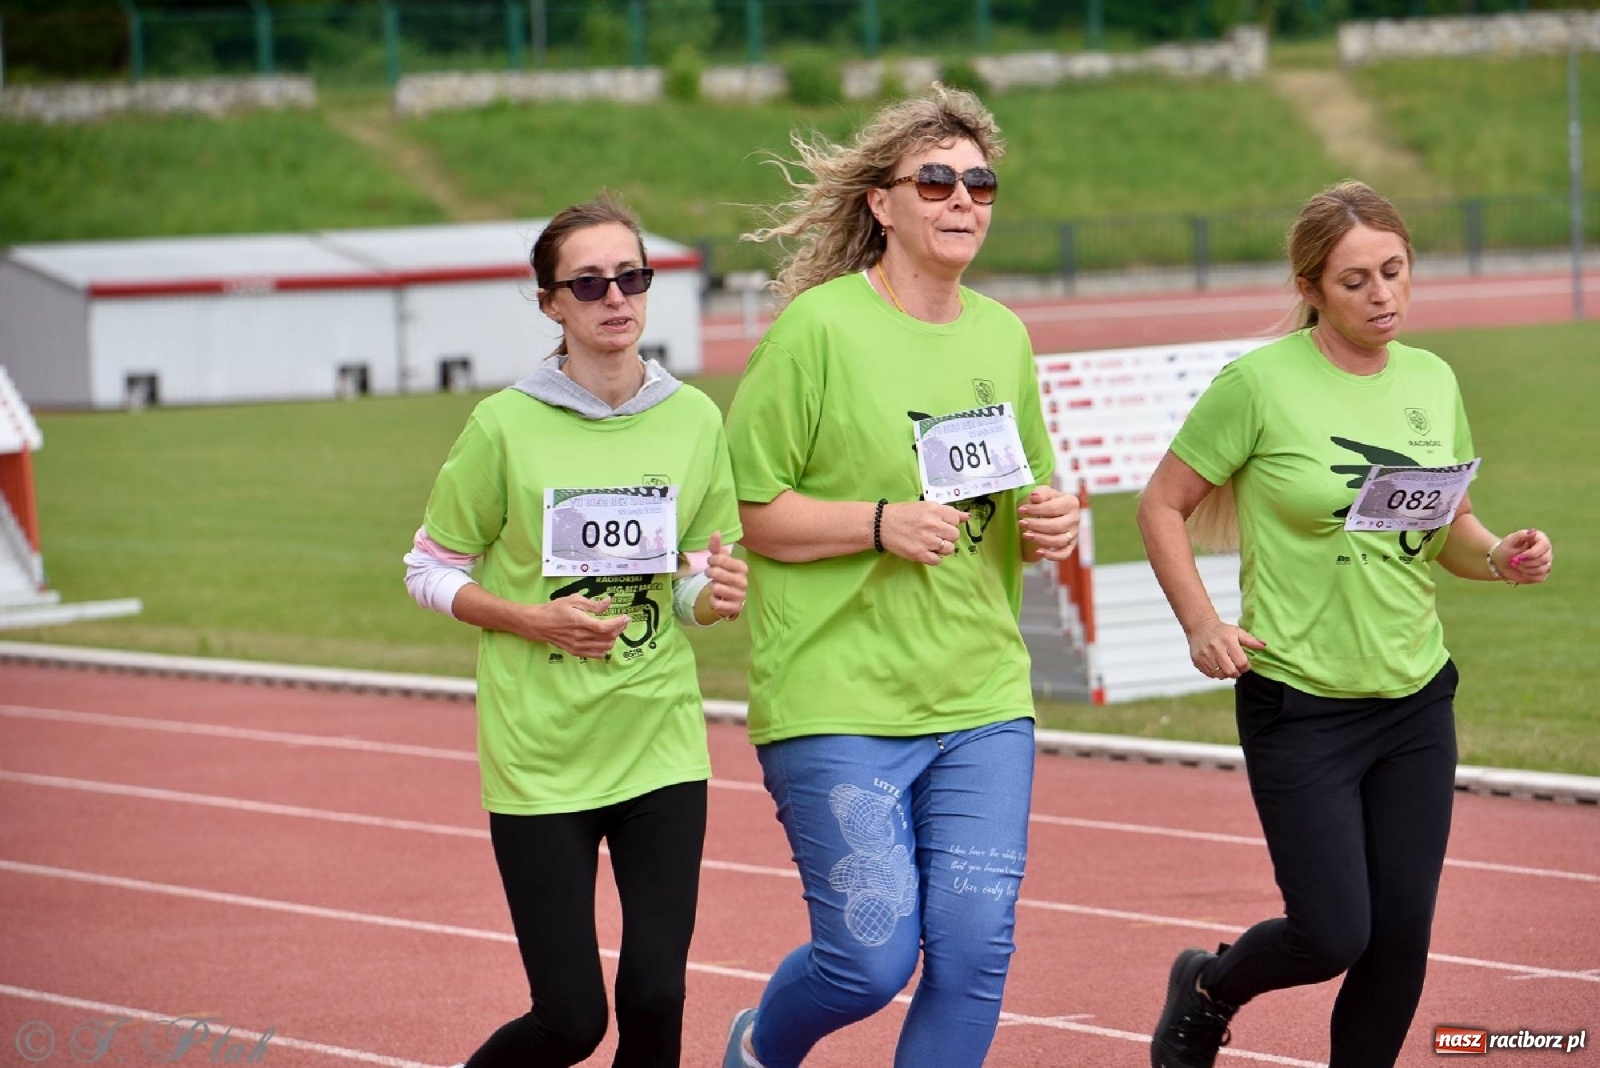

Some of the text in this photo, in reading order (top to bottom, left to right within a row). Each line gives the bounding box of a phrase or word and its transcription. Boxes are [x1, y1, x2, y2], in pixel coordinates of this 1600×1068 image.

[949, 440, 991, 473] 081
[1387, 489, 1441, 511] 082
[581, 519, 642, 549] 080
